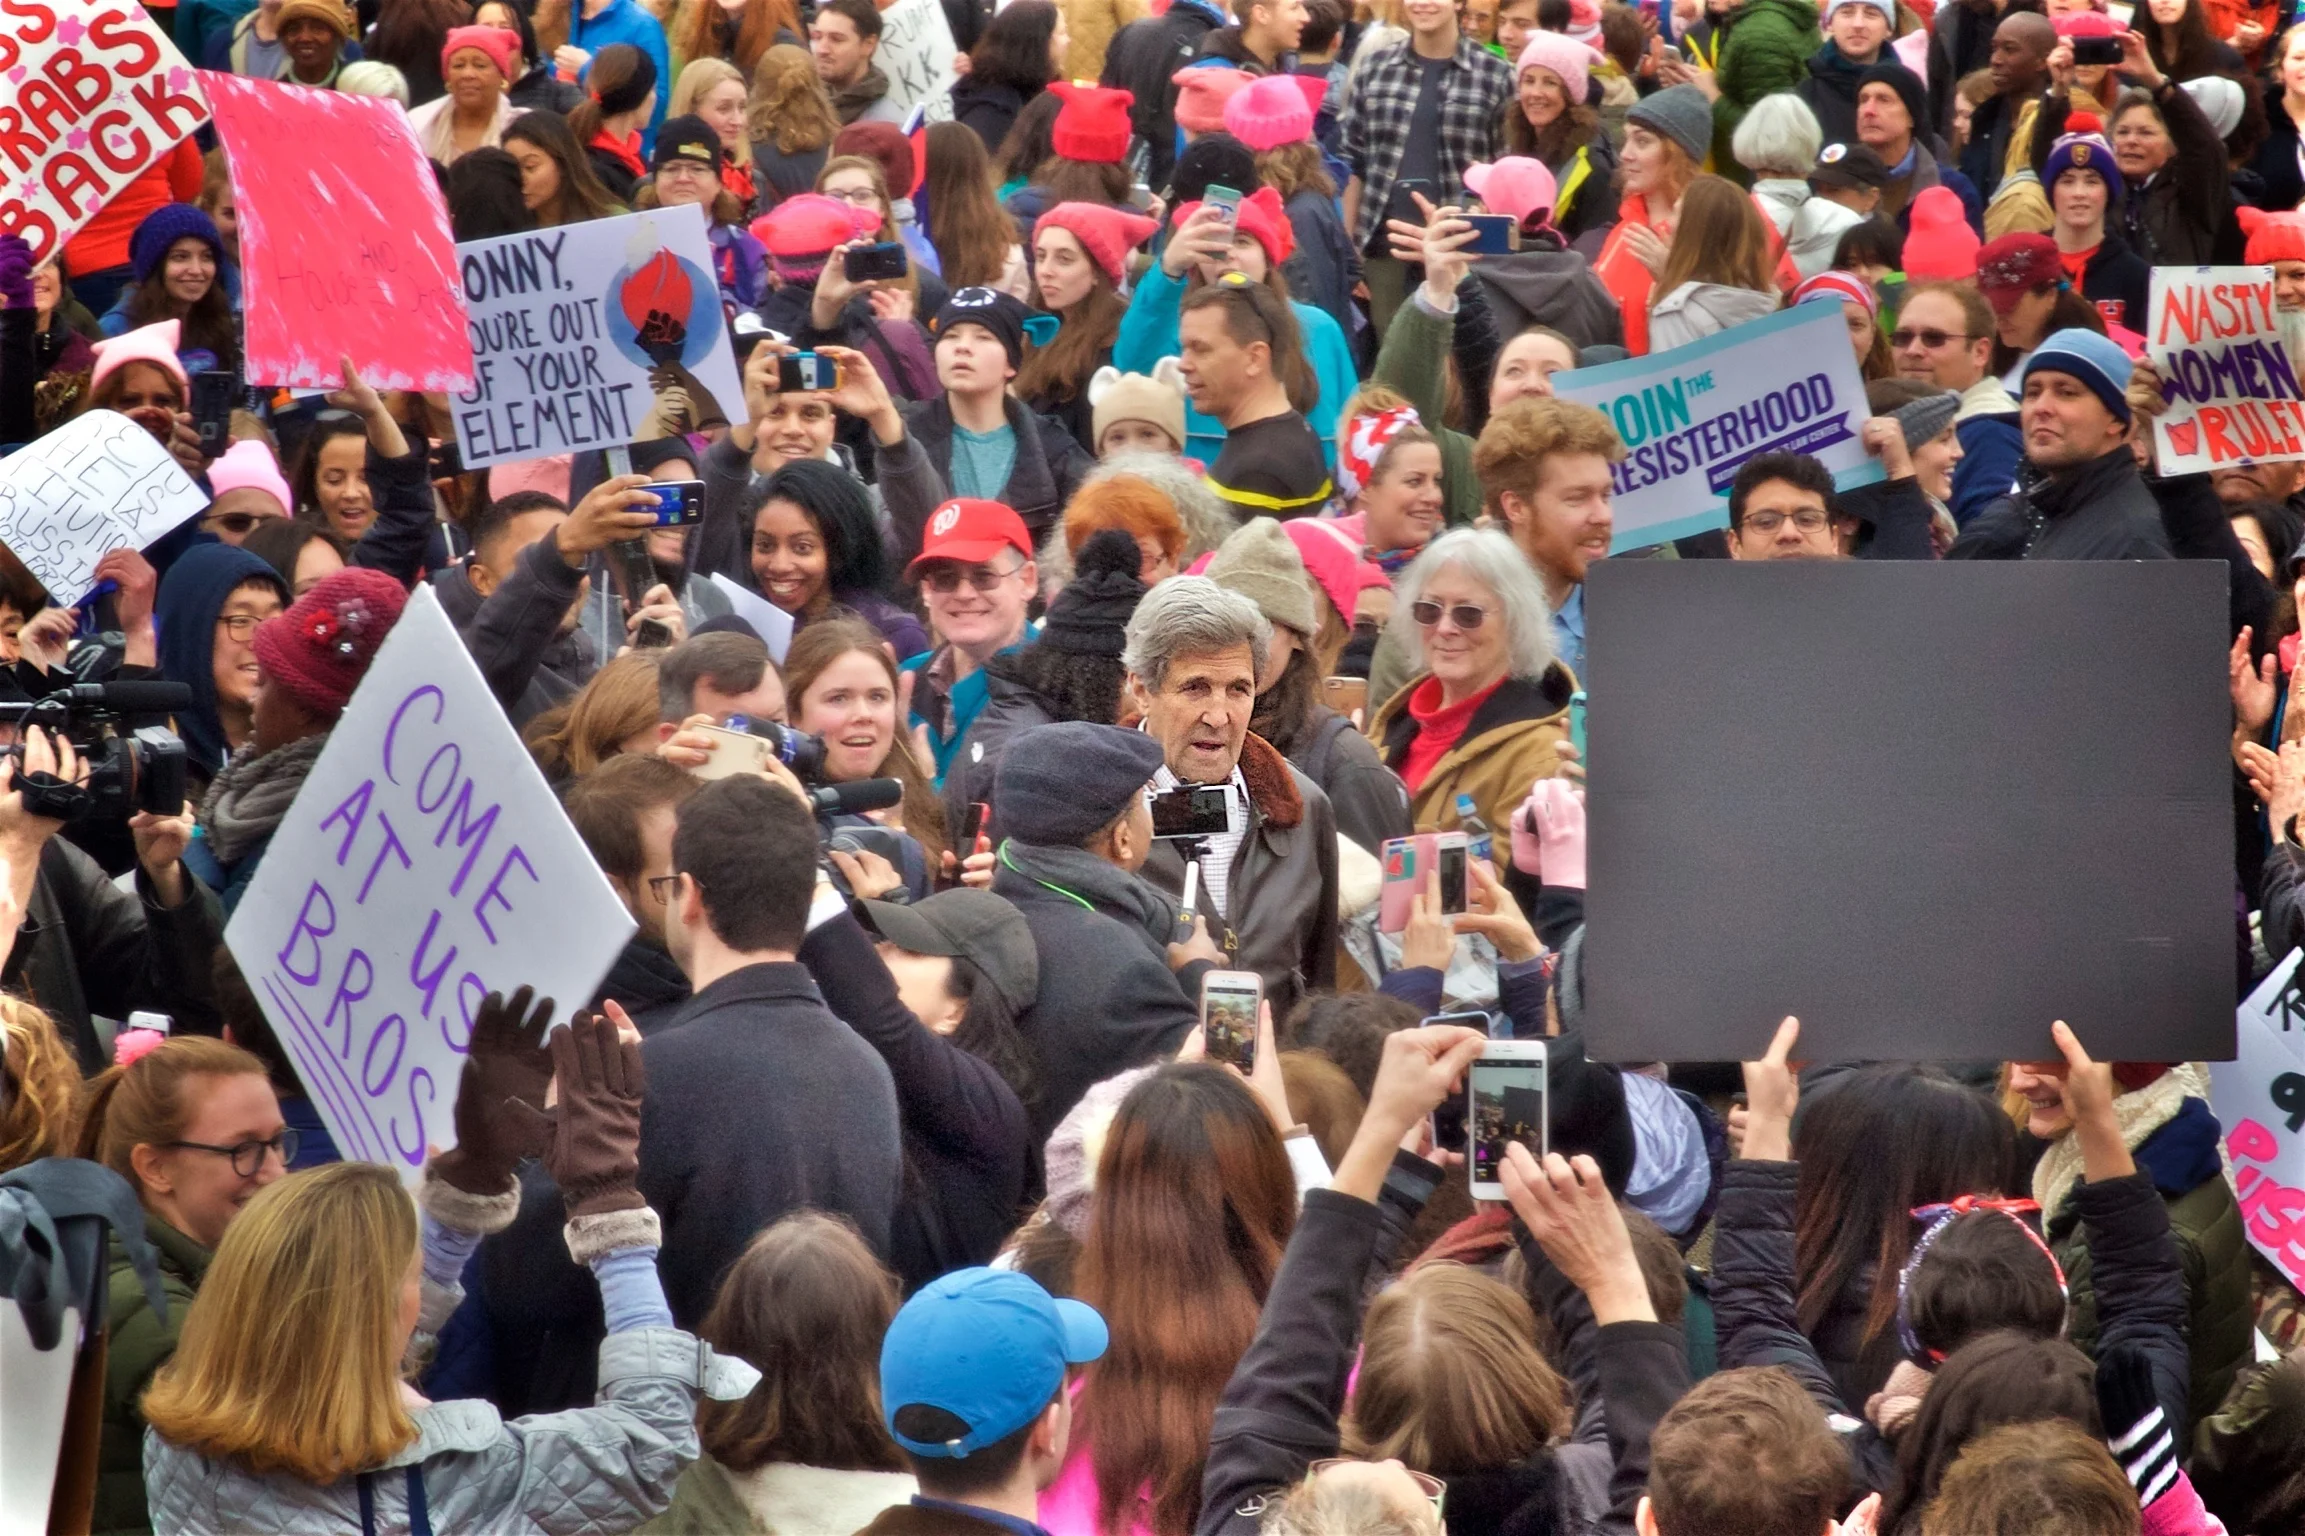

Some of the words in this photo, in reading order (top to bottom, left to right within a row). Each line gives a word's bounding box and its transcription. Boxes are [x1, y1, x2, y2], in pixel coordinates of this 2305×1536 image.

[0, 9, 160, 187] RABS
[0, 73, 208, 265] BACK
[549, 298, 599, 344] OUT
[2157, 281, 2276, 345] NASTY
[514, 345, 605, 395] YOUR
[1598, 376, 1692, 447] OIN
[1684, 370, 1717, 398] THE
[2162, 339, 2305, 406] WOMEN
[461, 383, 633, 461] ELEMENT
[0, 515, 29, 554] OTE
[382, 683, 540, 945] COME
[319, 777, 413, 905] AT
[410, 908, 490, 1055] US
[277, 879, 435, 1167] BROS
